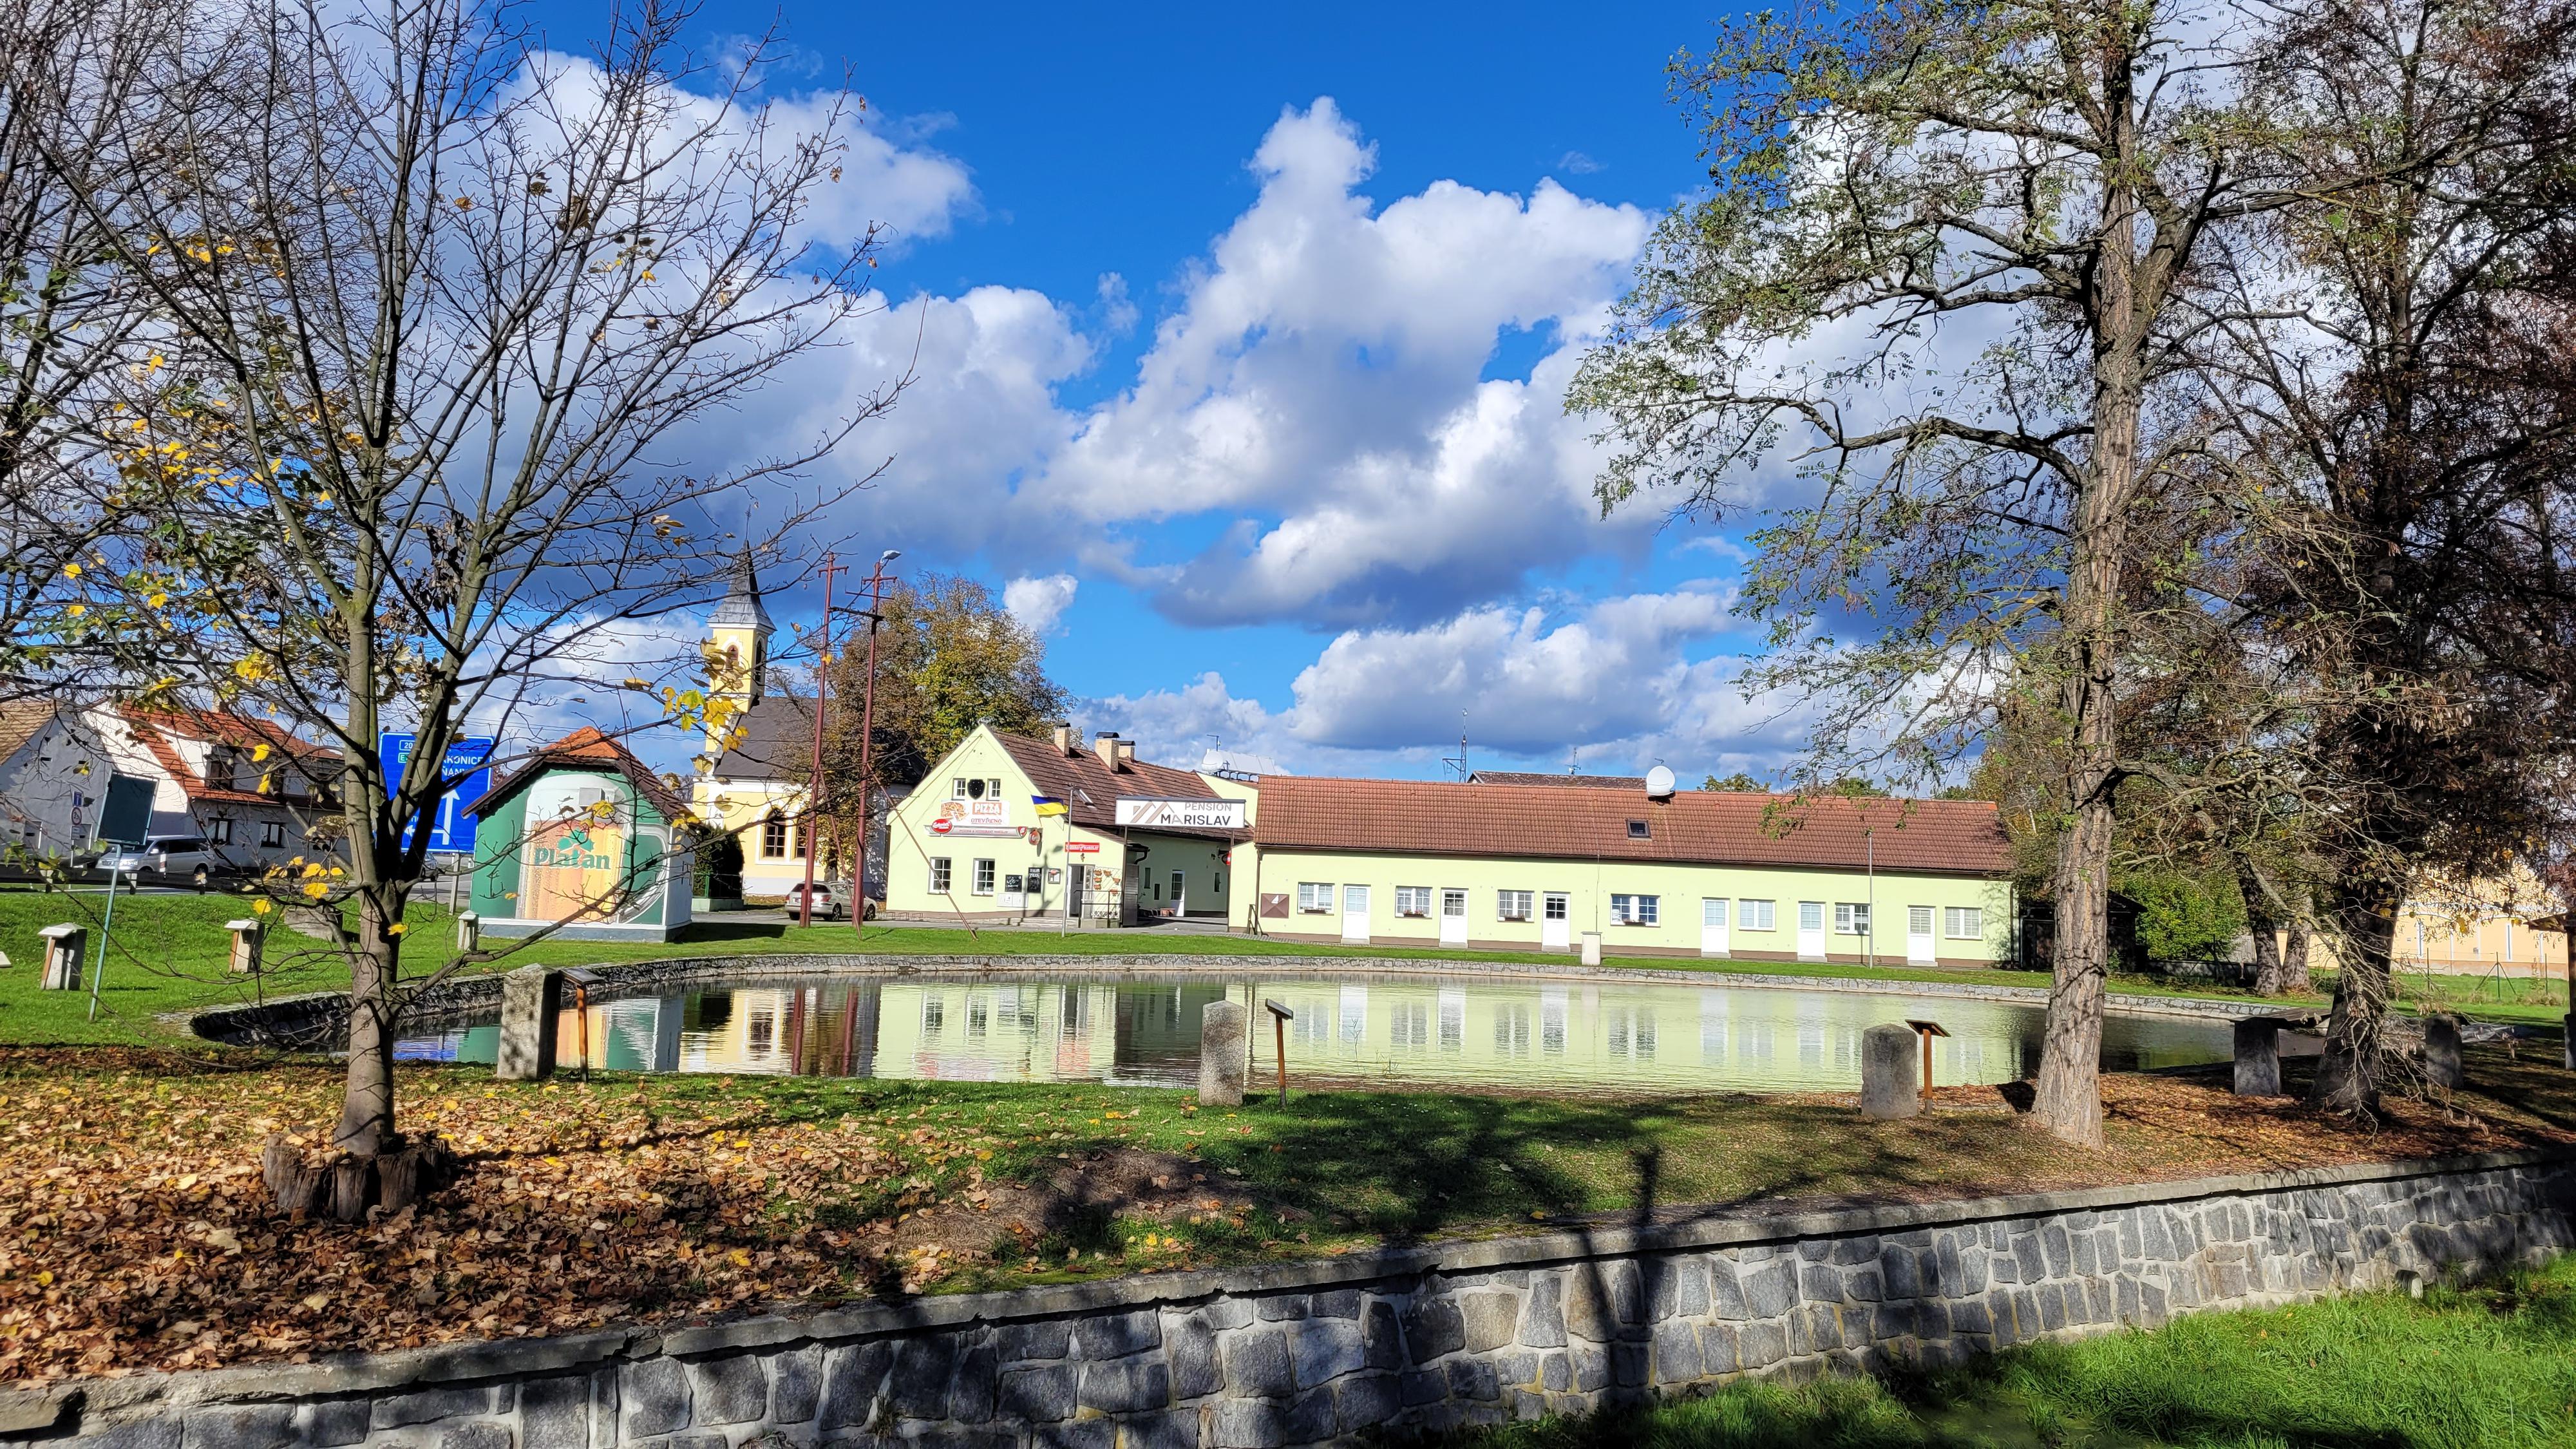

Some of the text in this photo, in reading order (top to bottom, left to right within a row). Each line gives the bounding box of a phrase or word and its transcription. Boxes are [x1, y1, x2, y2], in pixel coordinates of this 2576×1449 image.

[444, 755, 484, 765] KONICE
[974, 802, 1001, 815] PIZZA
[1184, 802, 1232, 811] PENSION
[1160, 813, 1231, 826] MARISLAV
[535, 848, 611, 869] Platan
